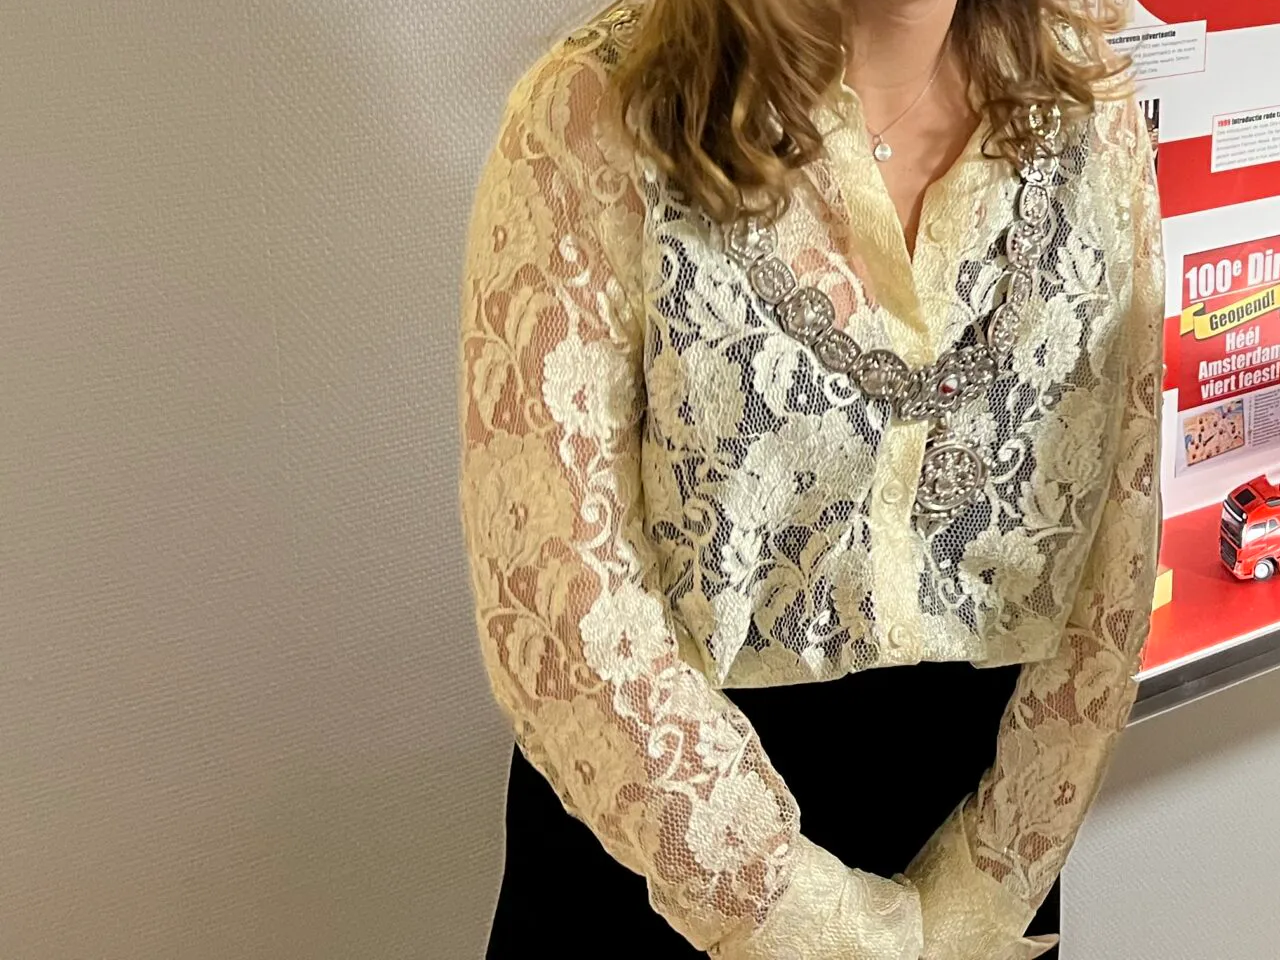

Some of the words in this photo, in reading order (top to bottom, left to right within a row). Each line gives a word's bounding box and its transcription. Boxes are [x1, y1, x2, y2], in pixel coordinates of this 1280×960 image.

[1263, 112, 1276, 120] rode
[1185, 259, 1242, 301] 100e
[1209, 289, 1276, 332] Geopend!
[1225, 324, 1260, 353] Héél
[1200, 375, 1237, 400] viert
[1238, 361, 1280, 390] feest!
